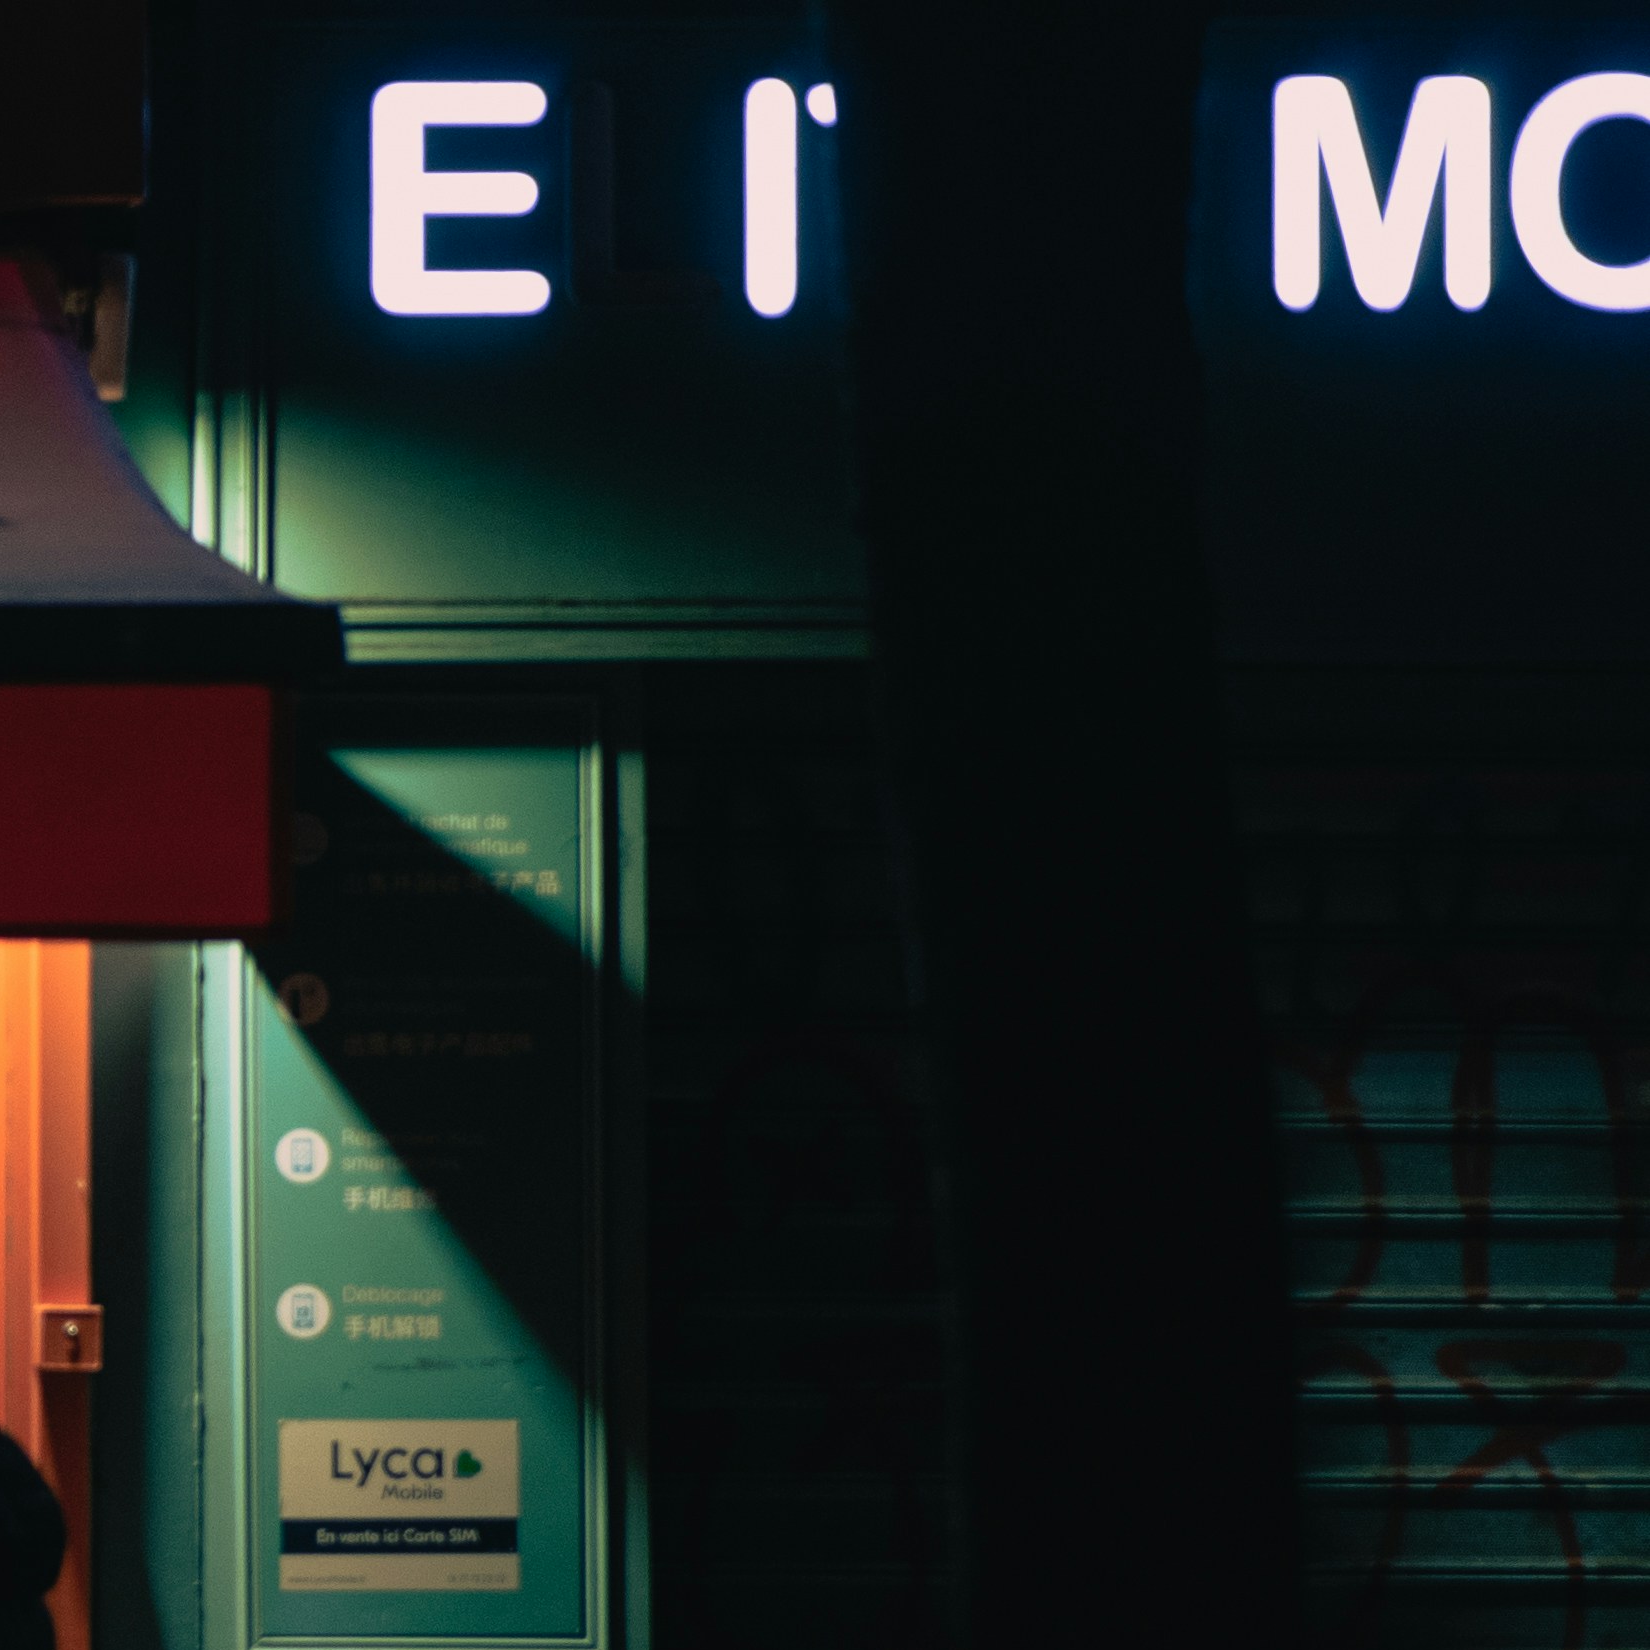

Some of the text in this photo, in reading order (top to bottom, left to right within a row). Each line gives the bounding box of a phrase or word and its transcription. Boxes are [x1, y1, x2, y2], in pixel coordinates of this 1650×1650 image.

[331, 1440, 444, 1488] Lyca
[380, 1485, 444, 1500] Mobile
[316, 1528, 336, 1544] En
[340, 1529, 380, 1543] vente
[383, 1528, 399, 1543] ici
[403, 1527, 444, 1543] Carte
